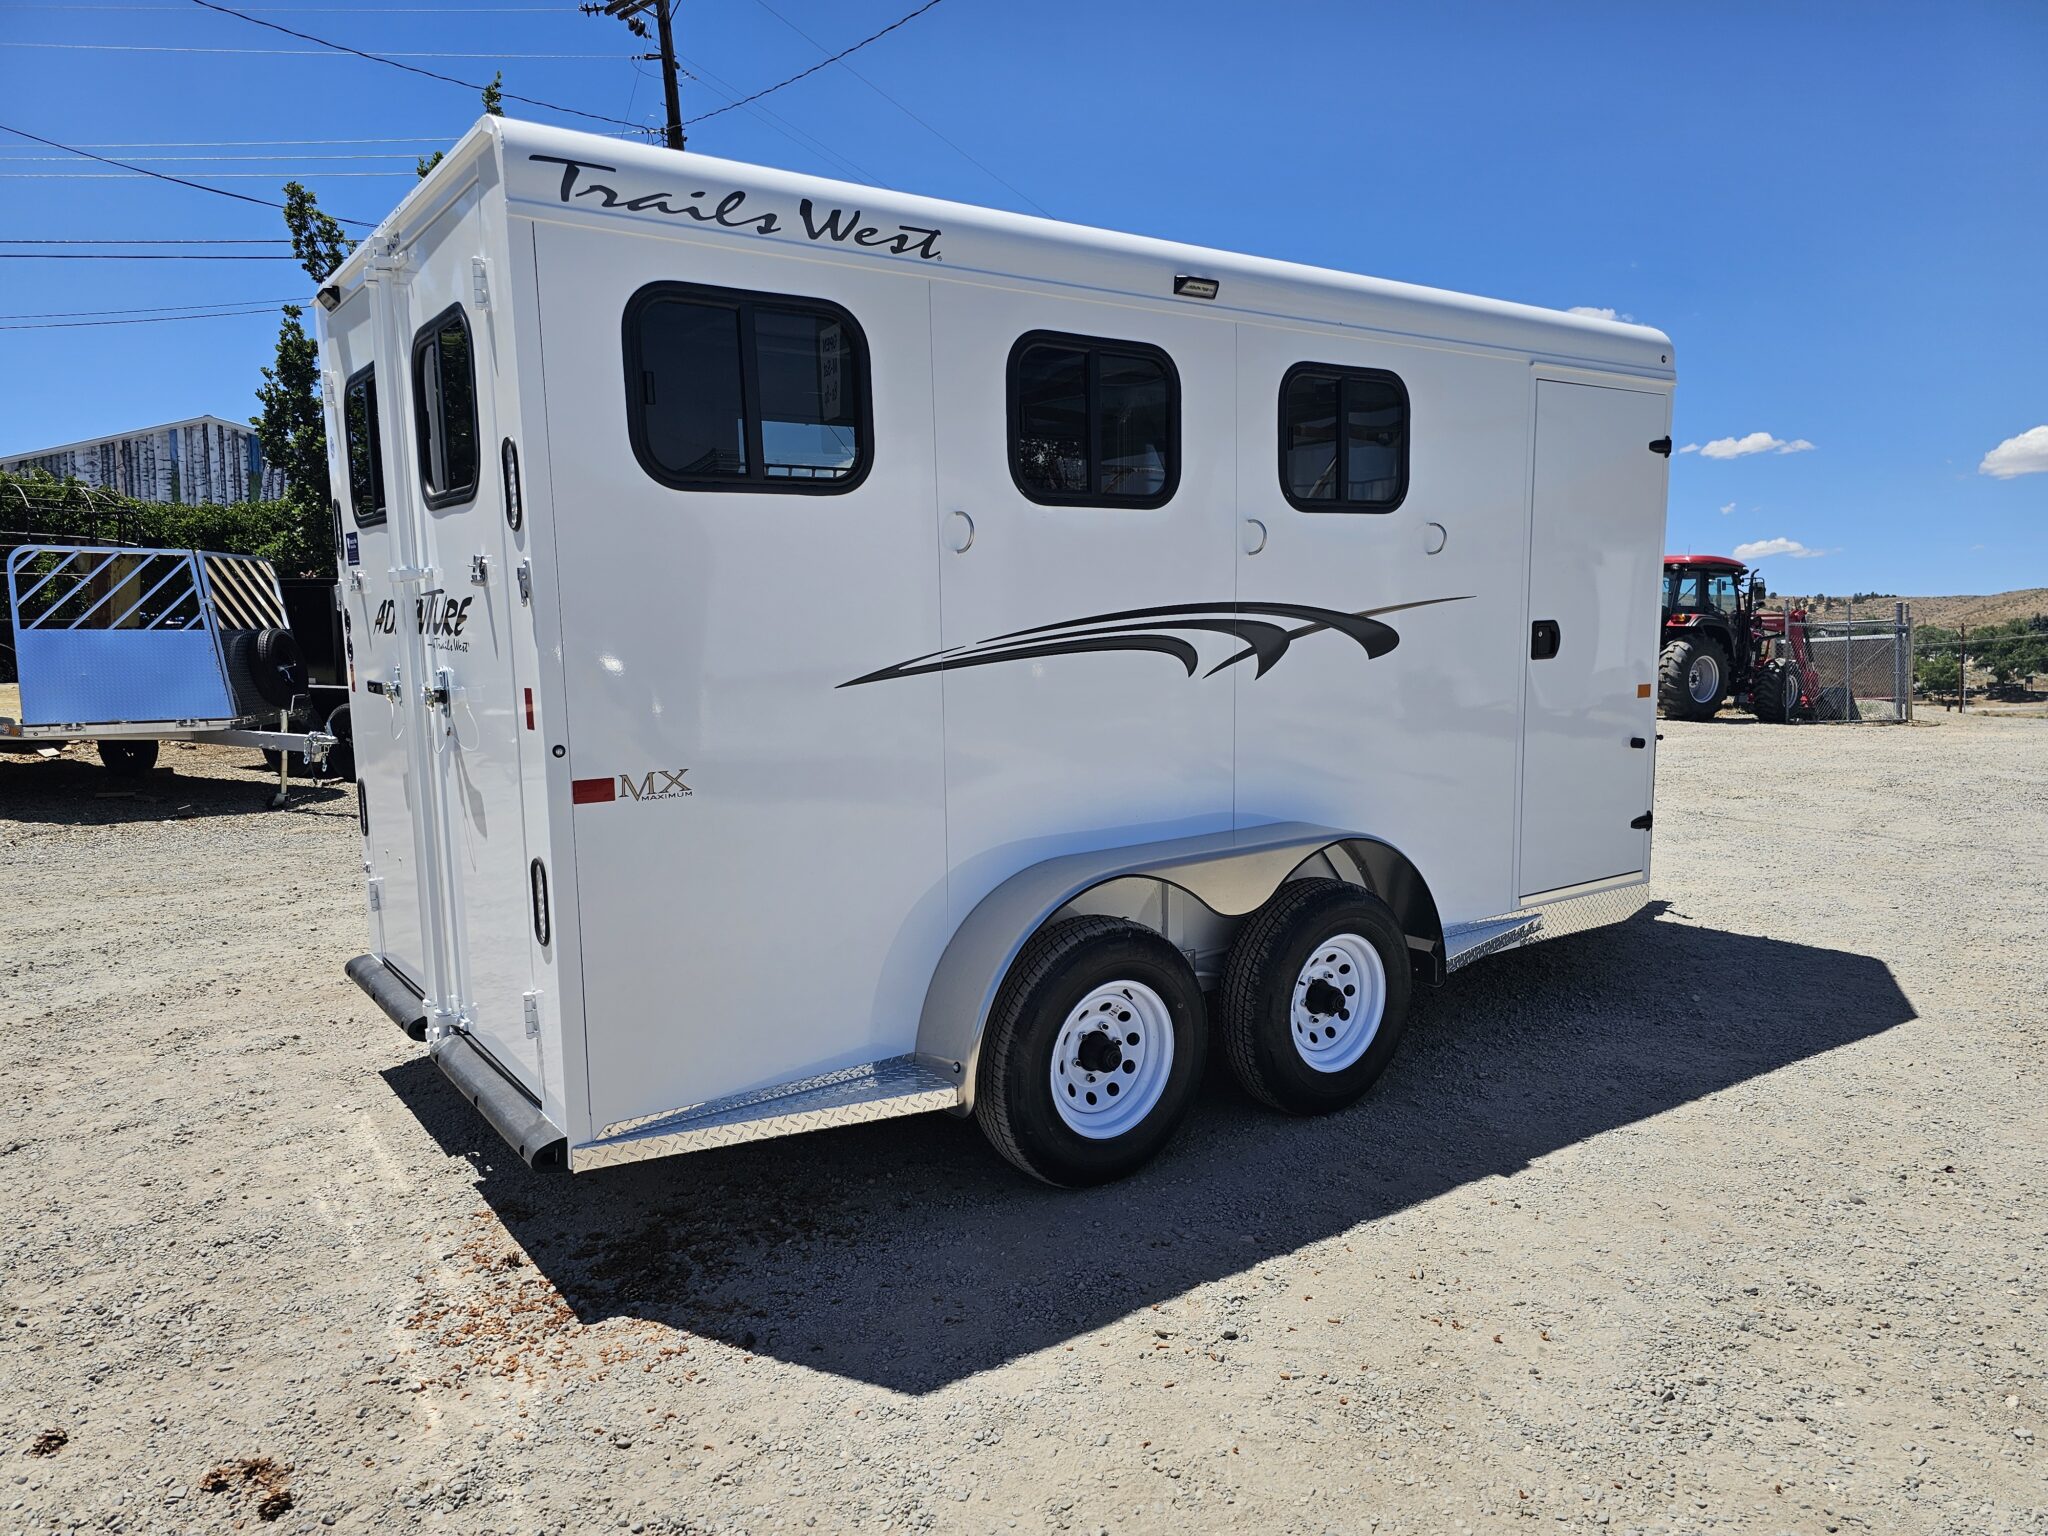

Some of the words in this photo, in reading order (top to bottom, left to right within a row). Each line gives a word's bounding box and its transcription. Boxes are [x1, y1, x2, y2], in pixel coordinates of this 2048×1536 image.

[529, 154, 781, 235] Trails
[618, 768, 692, 802] MX
[641, 791, 693, 802] MAXIMUM
